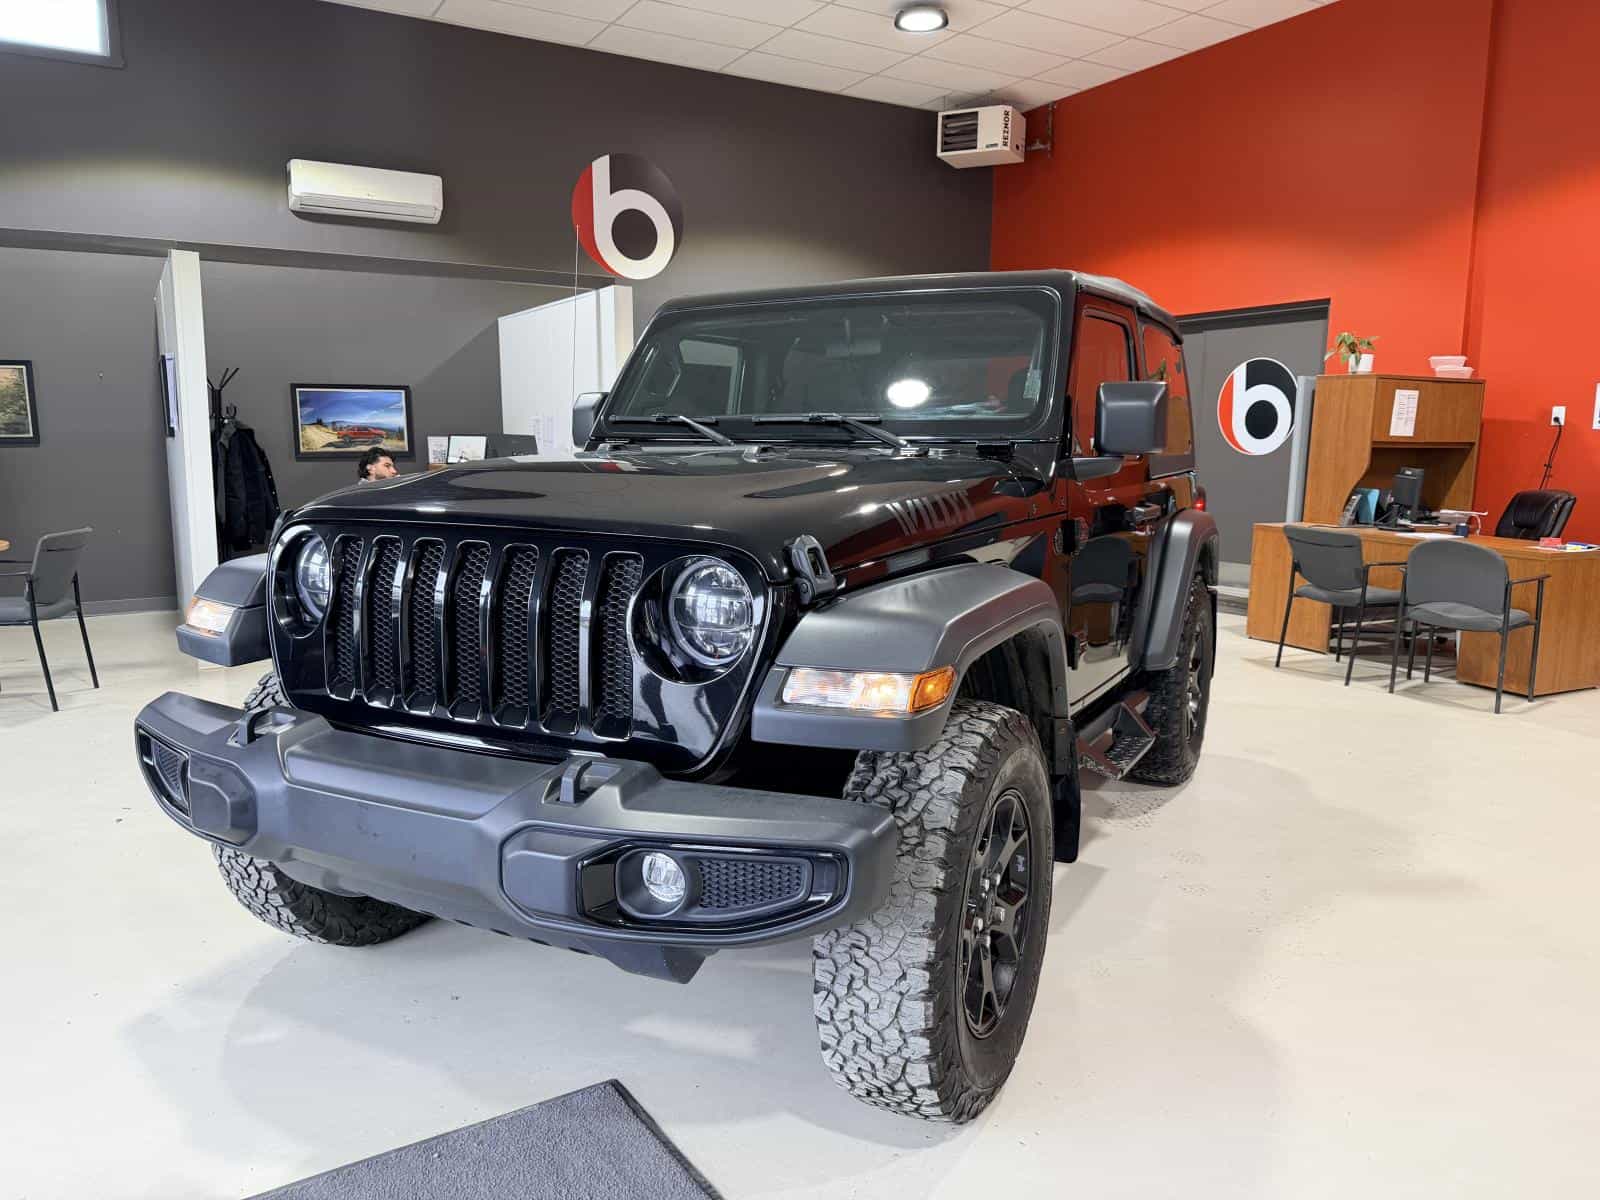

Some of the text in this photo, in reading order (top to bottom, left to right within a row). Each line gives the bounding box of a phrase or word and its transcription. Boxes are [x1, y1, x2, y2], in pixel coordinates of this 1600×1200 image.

[1002, 109, 1011, 147] REZNOR
[591, 154, 675, 280] b
[1232, 361, 1292, 455] b
